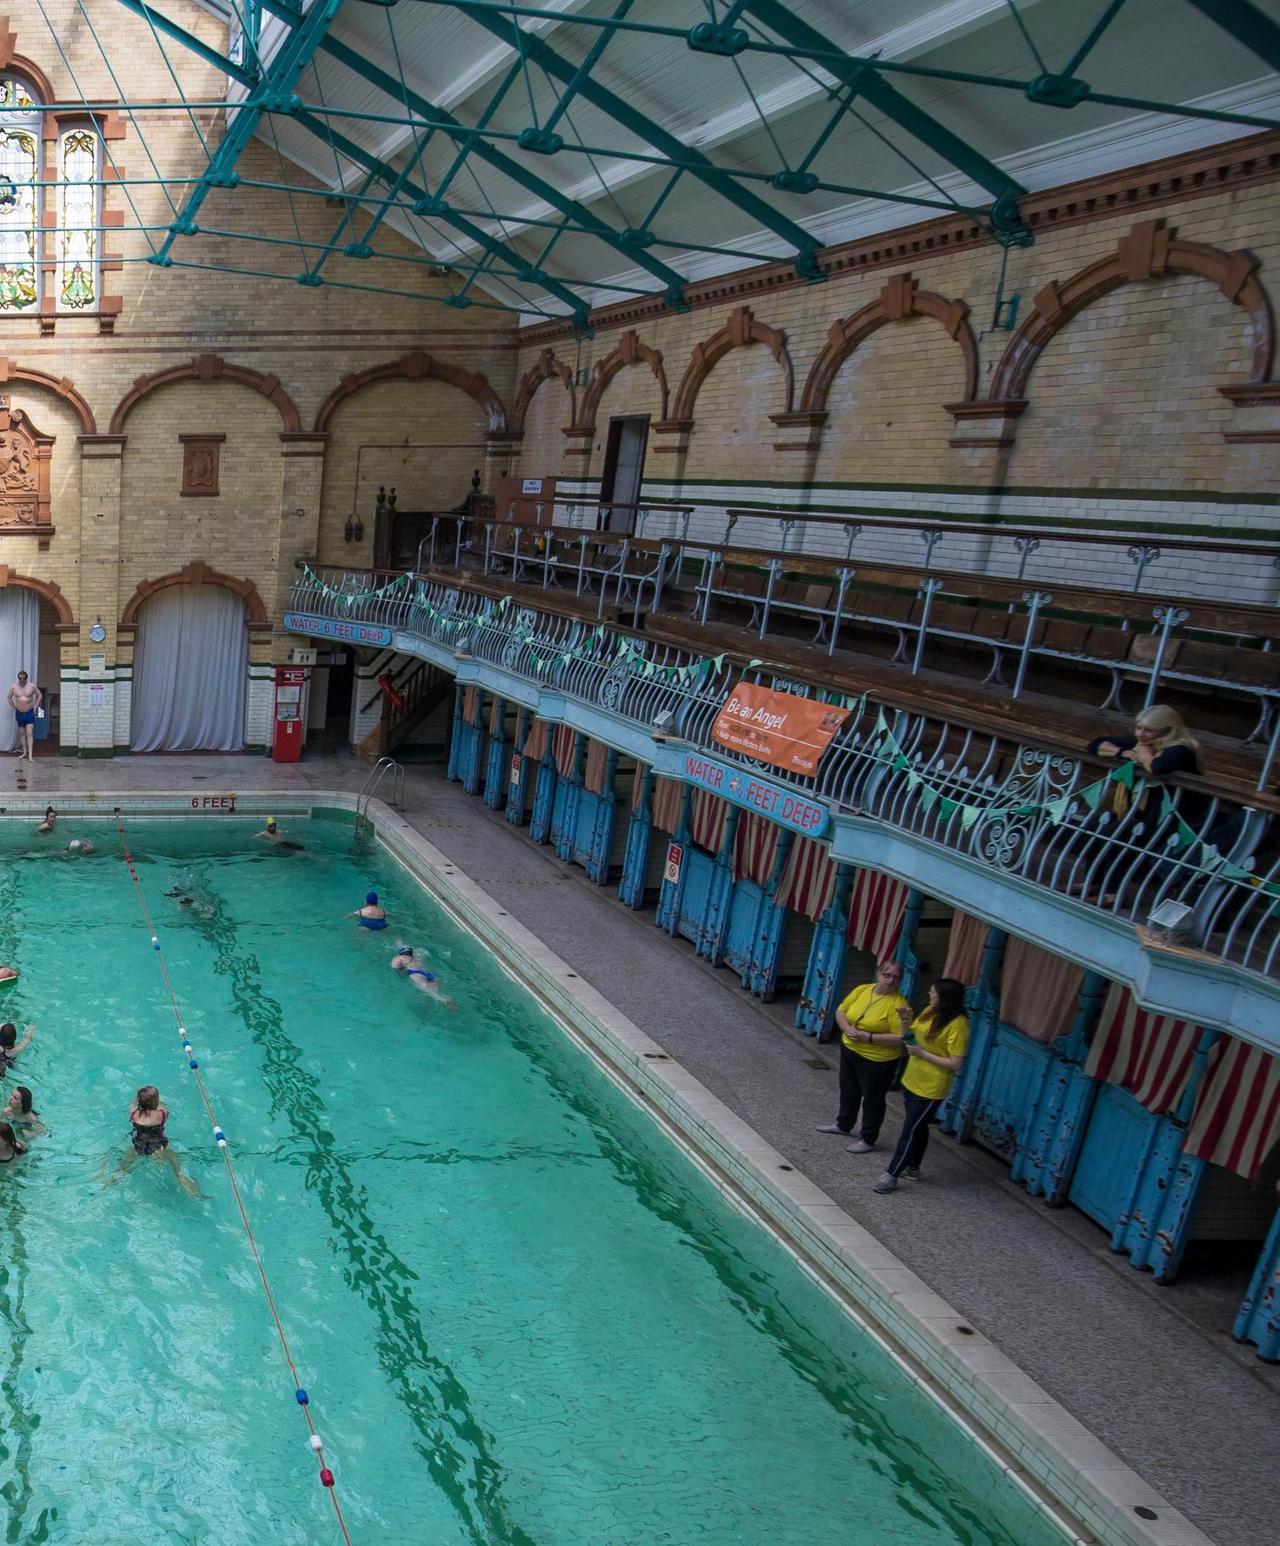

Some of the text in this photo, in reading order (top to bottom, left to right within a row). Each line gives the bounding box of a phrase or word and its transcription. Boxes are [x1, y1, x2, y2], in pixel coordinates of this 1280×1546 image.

[291, 617, 384, 641] WATER 6 FEET DEEP
[727, 698, 788, 729] Be an Angel
[191, 797, 238, 808] 6 FEET
[686, 757, 723, 787] WATER
[747, 783, 779, 812] FEET
[782, 798, 821, 829] DEEP
